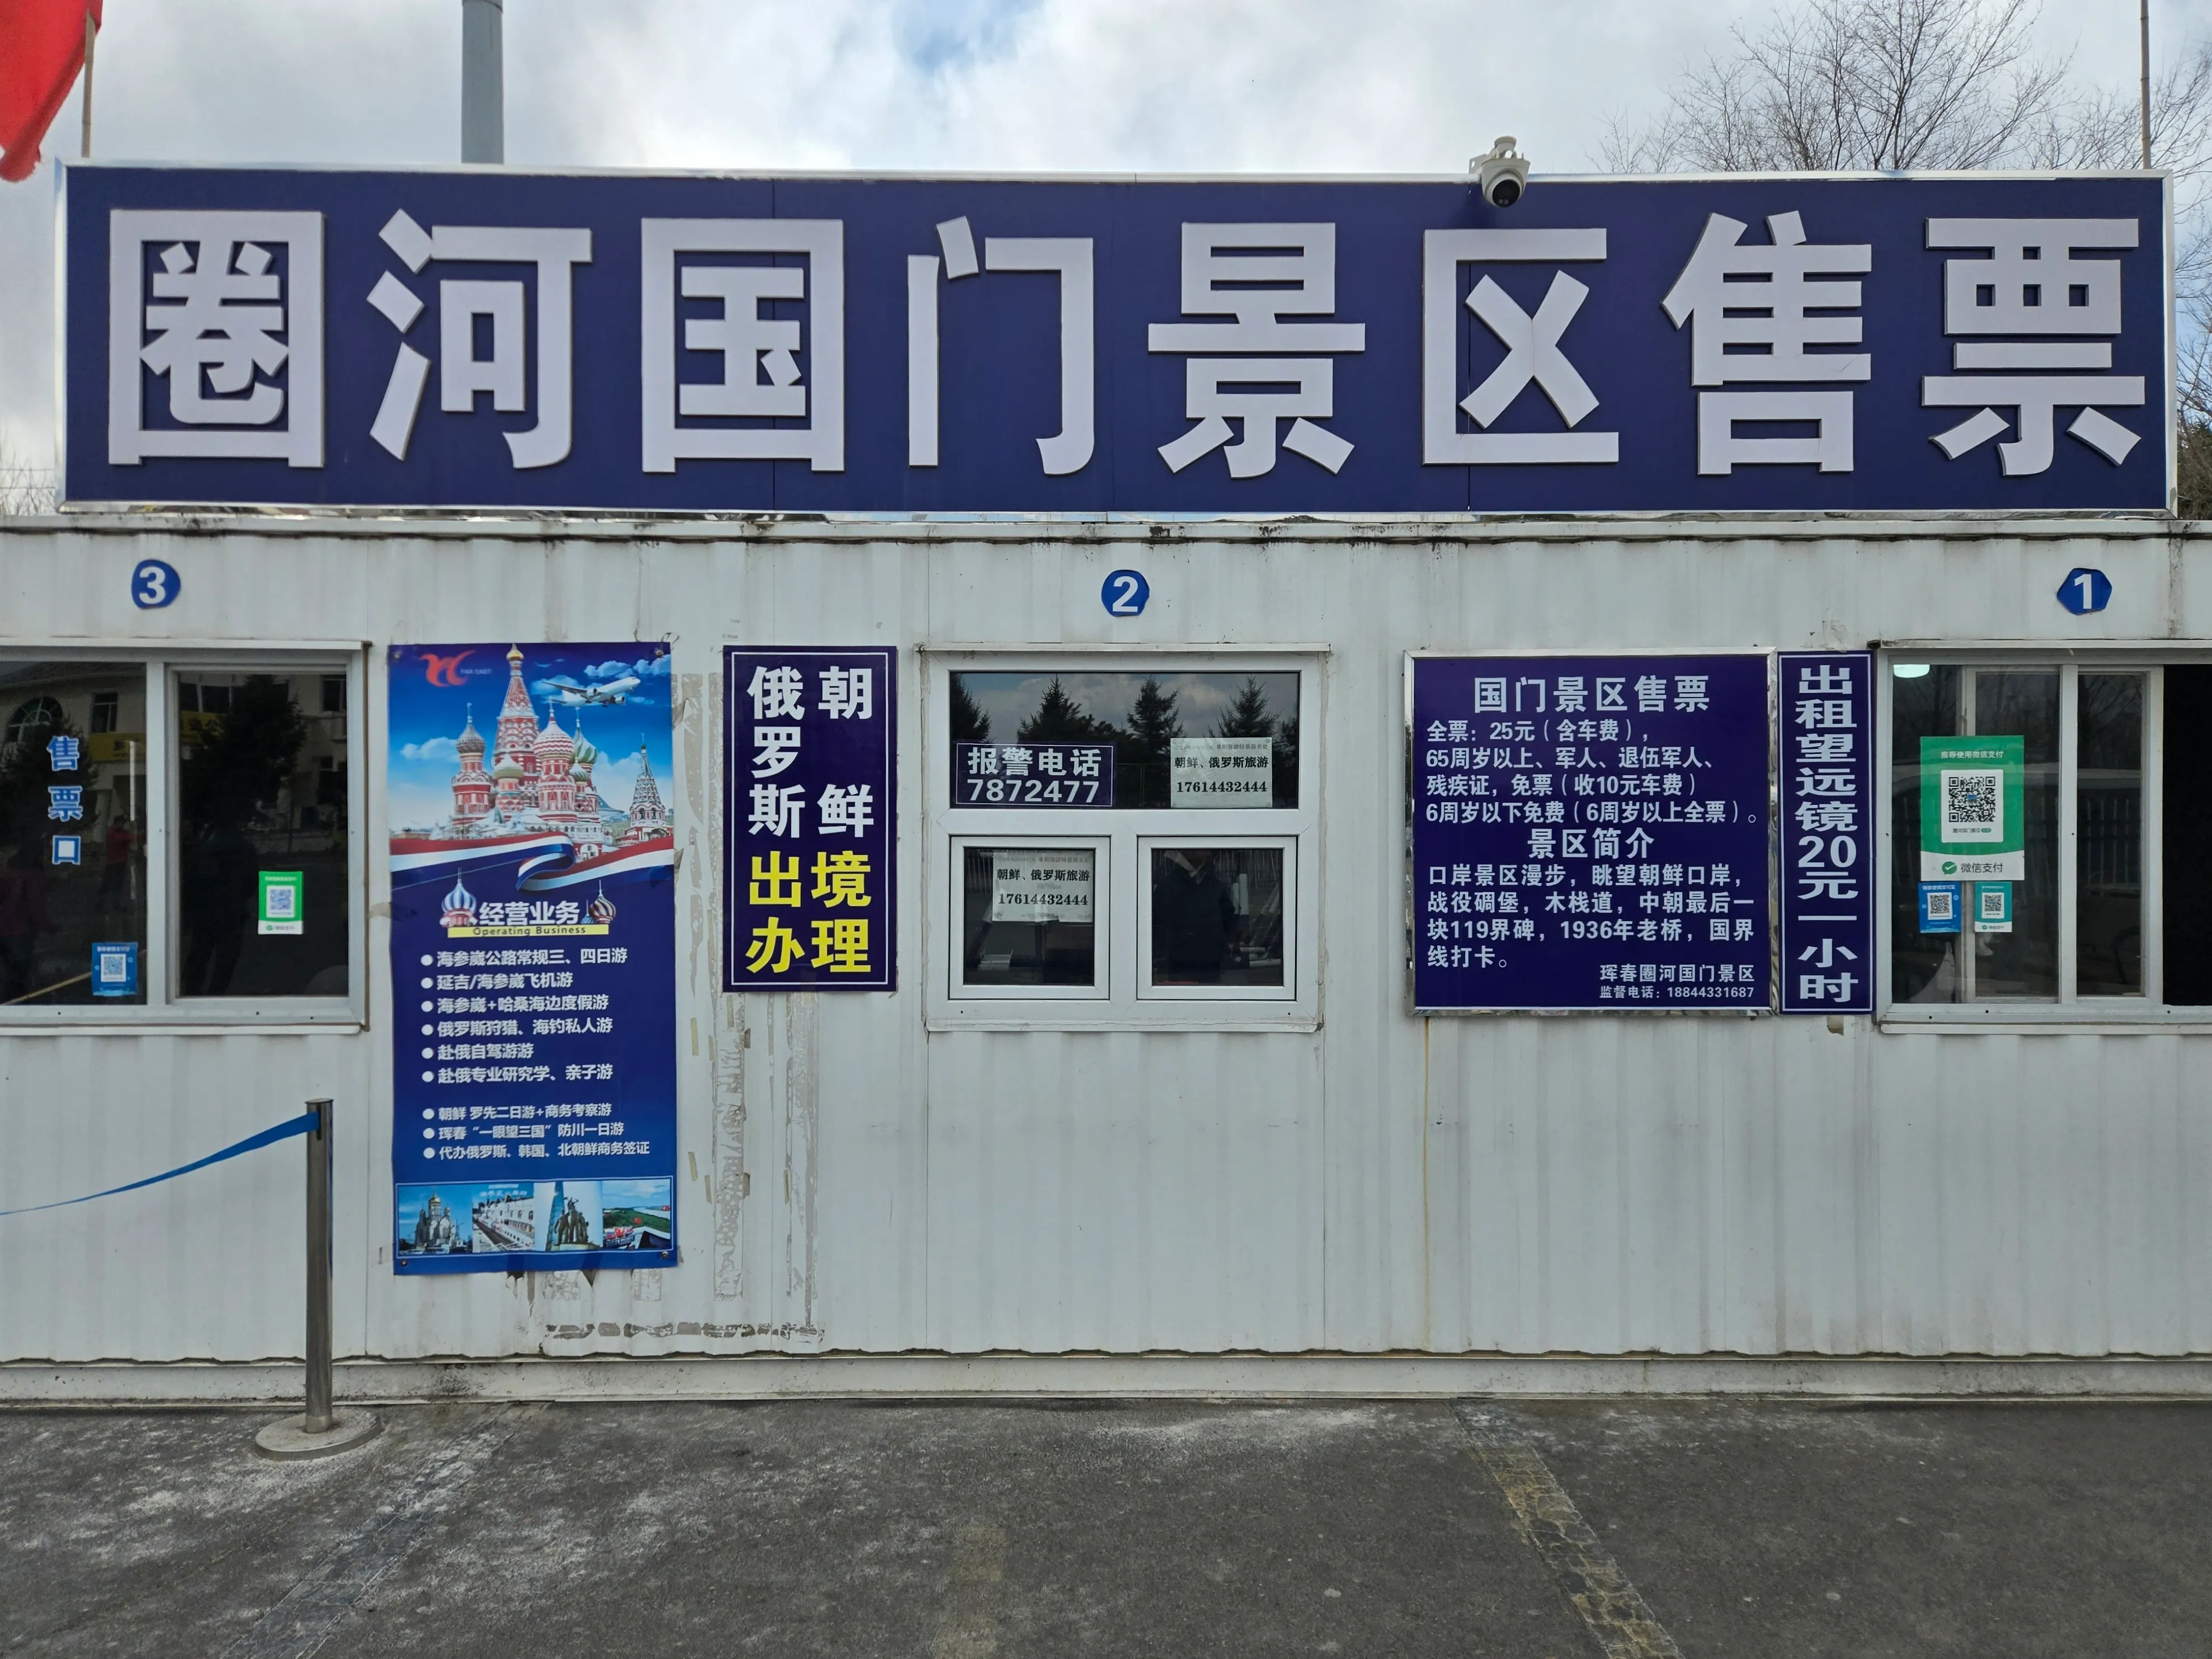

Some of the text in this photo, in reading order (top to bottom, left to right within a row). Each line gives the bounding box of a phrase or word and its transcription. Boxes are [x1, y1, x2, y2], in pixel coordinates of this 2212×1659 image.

[109, 209, 2145, 477] 圈河国门景区售票
[139, 566, 166, 605] 3
[1113, 576, 1138, 612] 2
[2074, 574, 2092, 609] 1
[1475, 675, 1709, 713] 国门景区售票
[747, 666, 805, 838] 俄罗斯
[817, 666, 873, 837] 朝鲜
[968, 747, 1102, 776] 报警电话
[1175, 756, 1268, 768] 朝鲜、俄罗斯旅游
[1427, 746, 1711, 769] 65周岁以上、军人、退伍军人、
[967, 779, 1099, 803] 7872477
[1177, 781, 1267, 792] 17614432444
[46, 736, 83, 865] 售票口
[1528, 827, 1654, 859] 景区简介
[1795, 665, 1858, 1002] 出租望远镜20元一小时
[750, 851, 871, 908] 出境
[997, 869, 1090, 881] 朝鲜、俄罗斯旅游
[1430, 864, 1740, 887] 口岸景区漫步，眺望朝鲜口岸，
[1961, 863, 2003, 873] 微信支付
[999, 894, 1088, 905] 17614432444
[1428, 891, 1754, 913] 战役碉堡，木栈道，中朝最后一
[479, 901, 580, 926] 经营业务
[473, 925, 586, 937] Operating Business
[1428, 918, 1754, 941] 块119界碑，1936年老桥，国界
[746, 917, 870, 973] 办理
[1428, 945, 1507, 968] 线打卡。
[437, 948, 627, 967] 海参崴公路常规三、四日游
[437, 972, 573, 990] 延吉/海参崴飞机游
[1601, 964, 1754, 982] 珲春圈河国门景区
[437, 994, 609, 1014] 海参崴+哈桑海边度假游
[437, 1017, 613, 1037] 俄罗斯狩猎、海钓私人游
[438, 1043, 534, 1060] 赴俄自驾游游
[438, 1063, 613, 1083] 赴俄专业研究学、亲子游
[439, 1103, 611, 1121] 朝鲜 罗先二日游+商务考察游
[439, 1141, 650, 1160] 代办俄罗斯、韩国、北朝鲜商务签证
